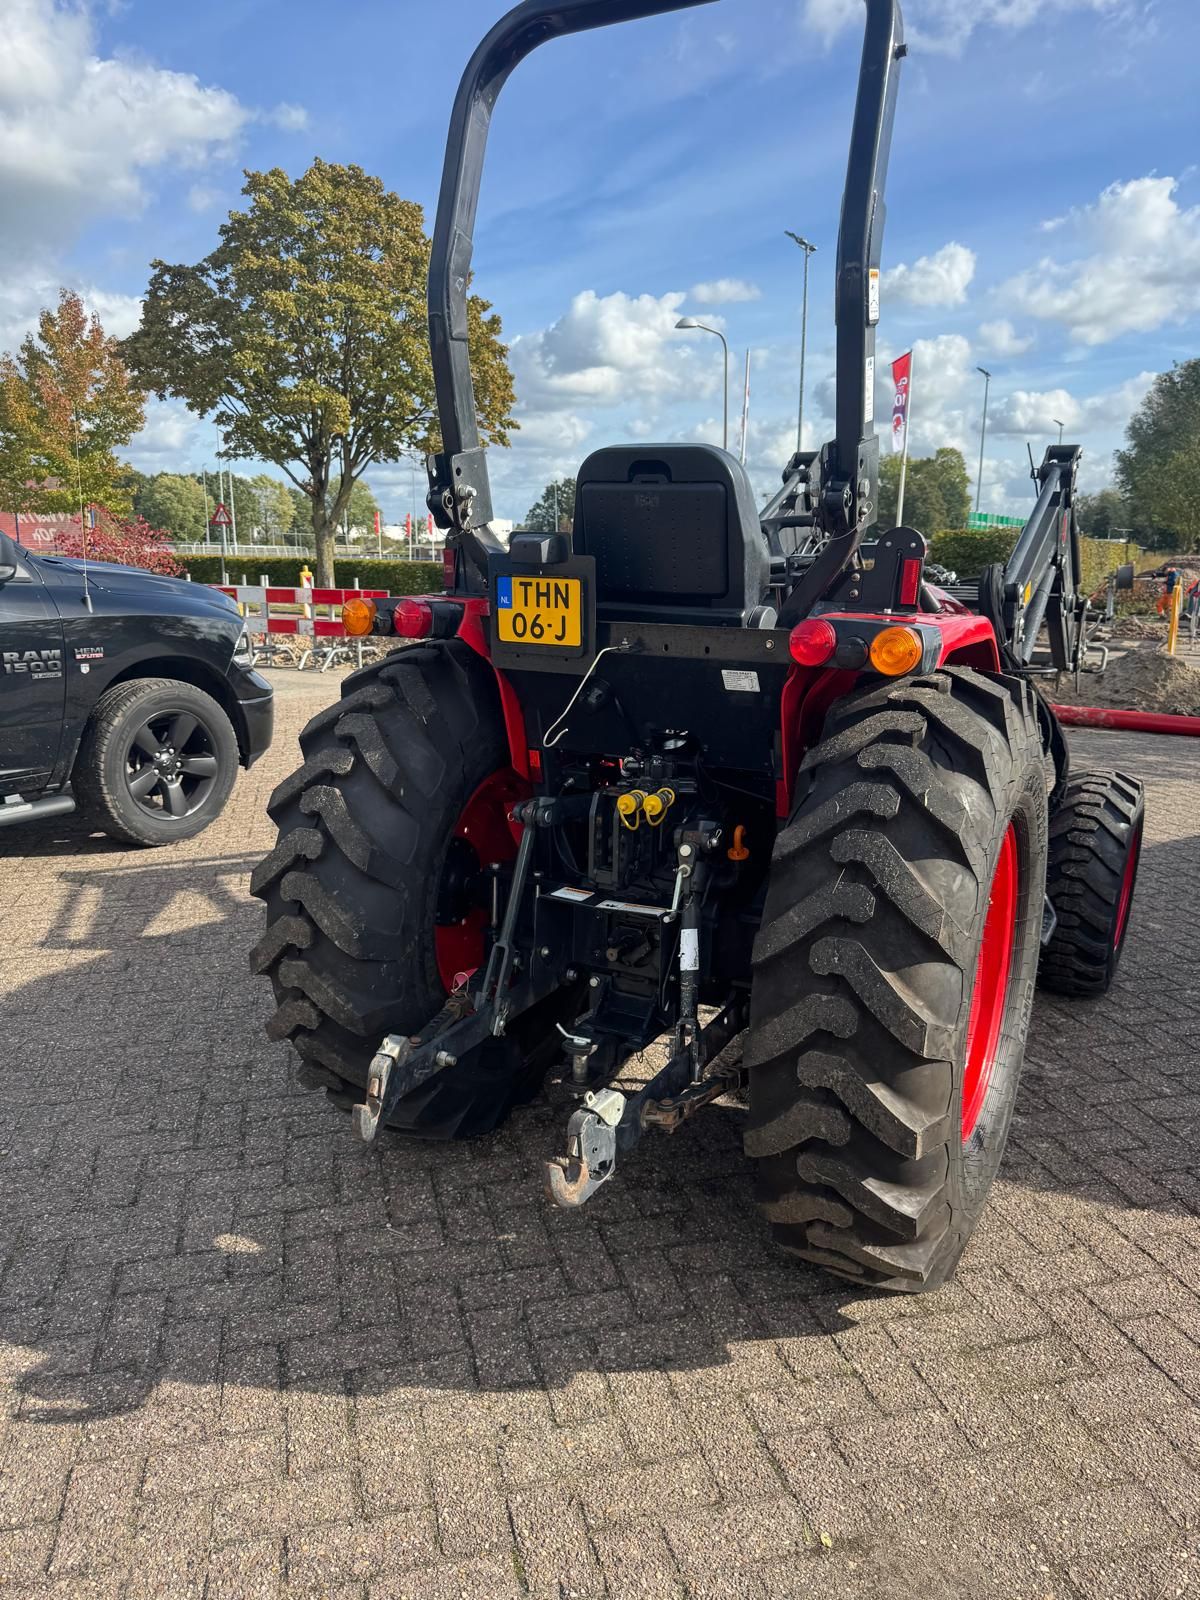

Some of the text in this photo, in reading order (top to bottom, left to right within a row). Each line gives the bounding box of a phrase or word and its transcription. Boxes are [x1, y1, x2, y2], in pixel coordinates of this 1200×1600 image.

[500, 596, 510, 604] NL
[519, 581, 569, 609] THN
[512, 612, 566, 641] 06-J
[3, 649, 61, 662] RAM
[74, 646, 104, 655] HEMI
[4, 660, 62, 674] 1500
